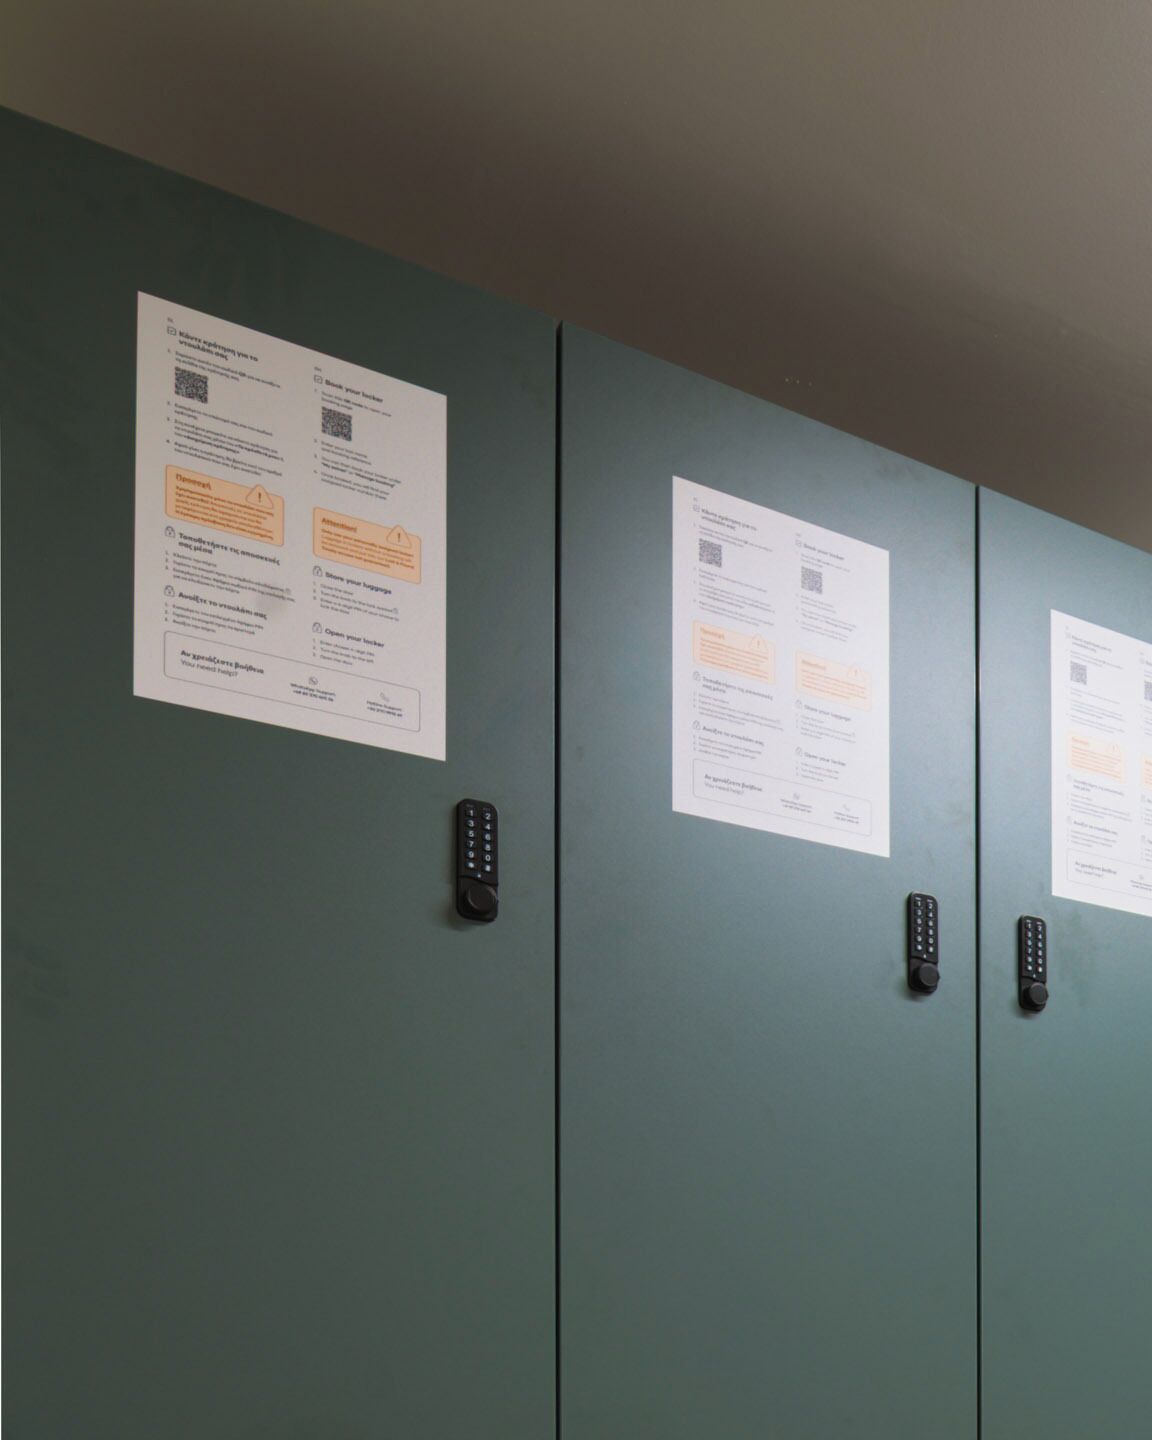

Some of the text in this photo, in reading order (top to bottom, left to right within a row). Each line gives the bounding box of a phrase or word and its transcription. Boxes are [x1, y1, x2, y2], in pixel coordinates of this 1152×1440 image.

[326, 380, 384, 404] Book your locker
[322, 517, 358, 534] Attention!
[326, 572, 392, 596] Store your luggage
[325, 629, 384, 648] Open your locker
[197, 663, 216, 672] need
[218, 668, 238, 679] help?
